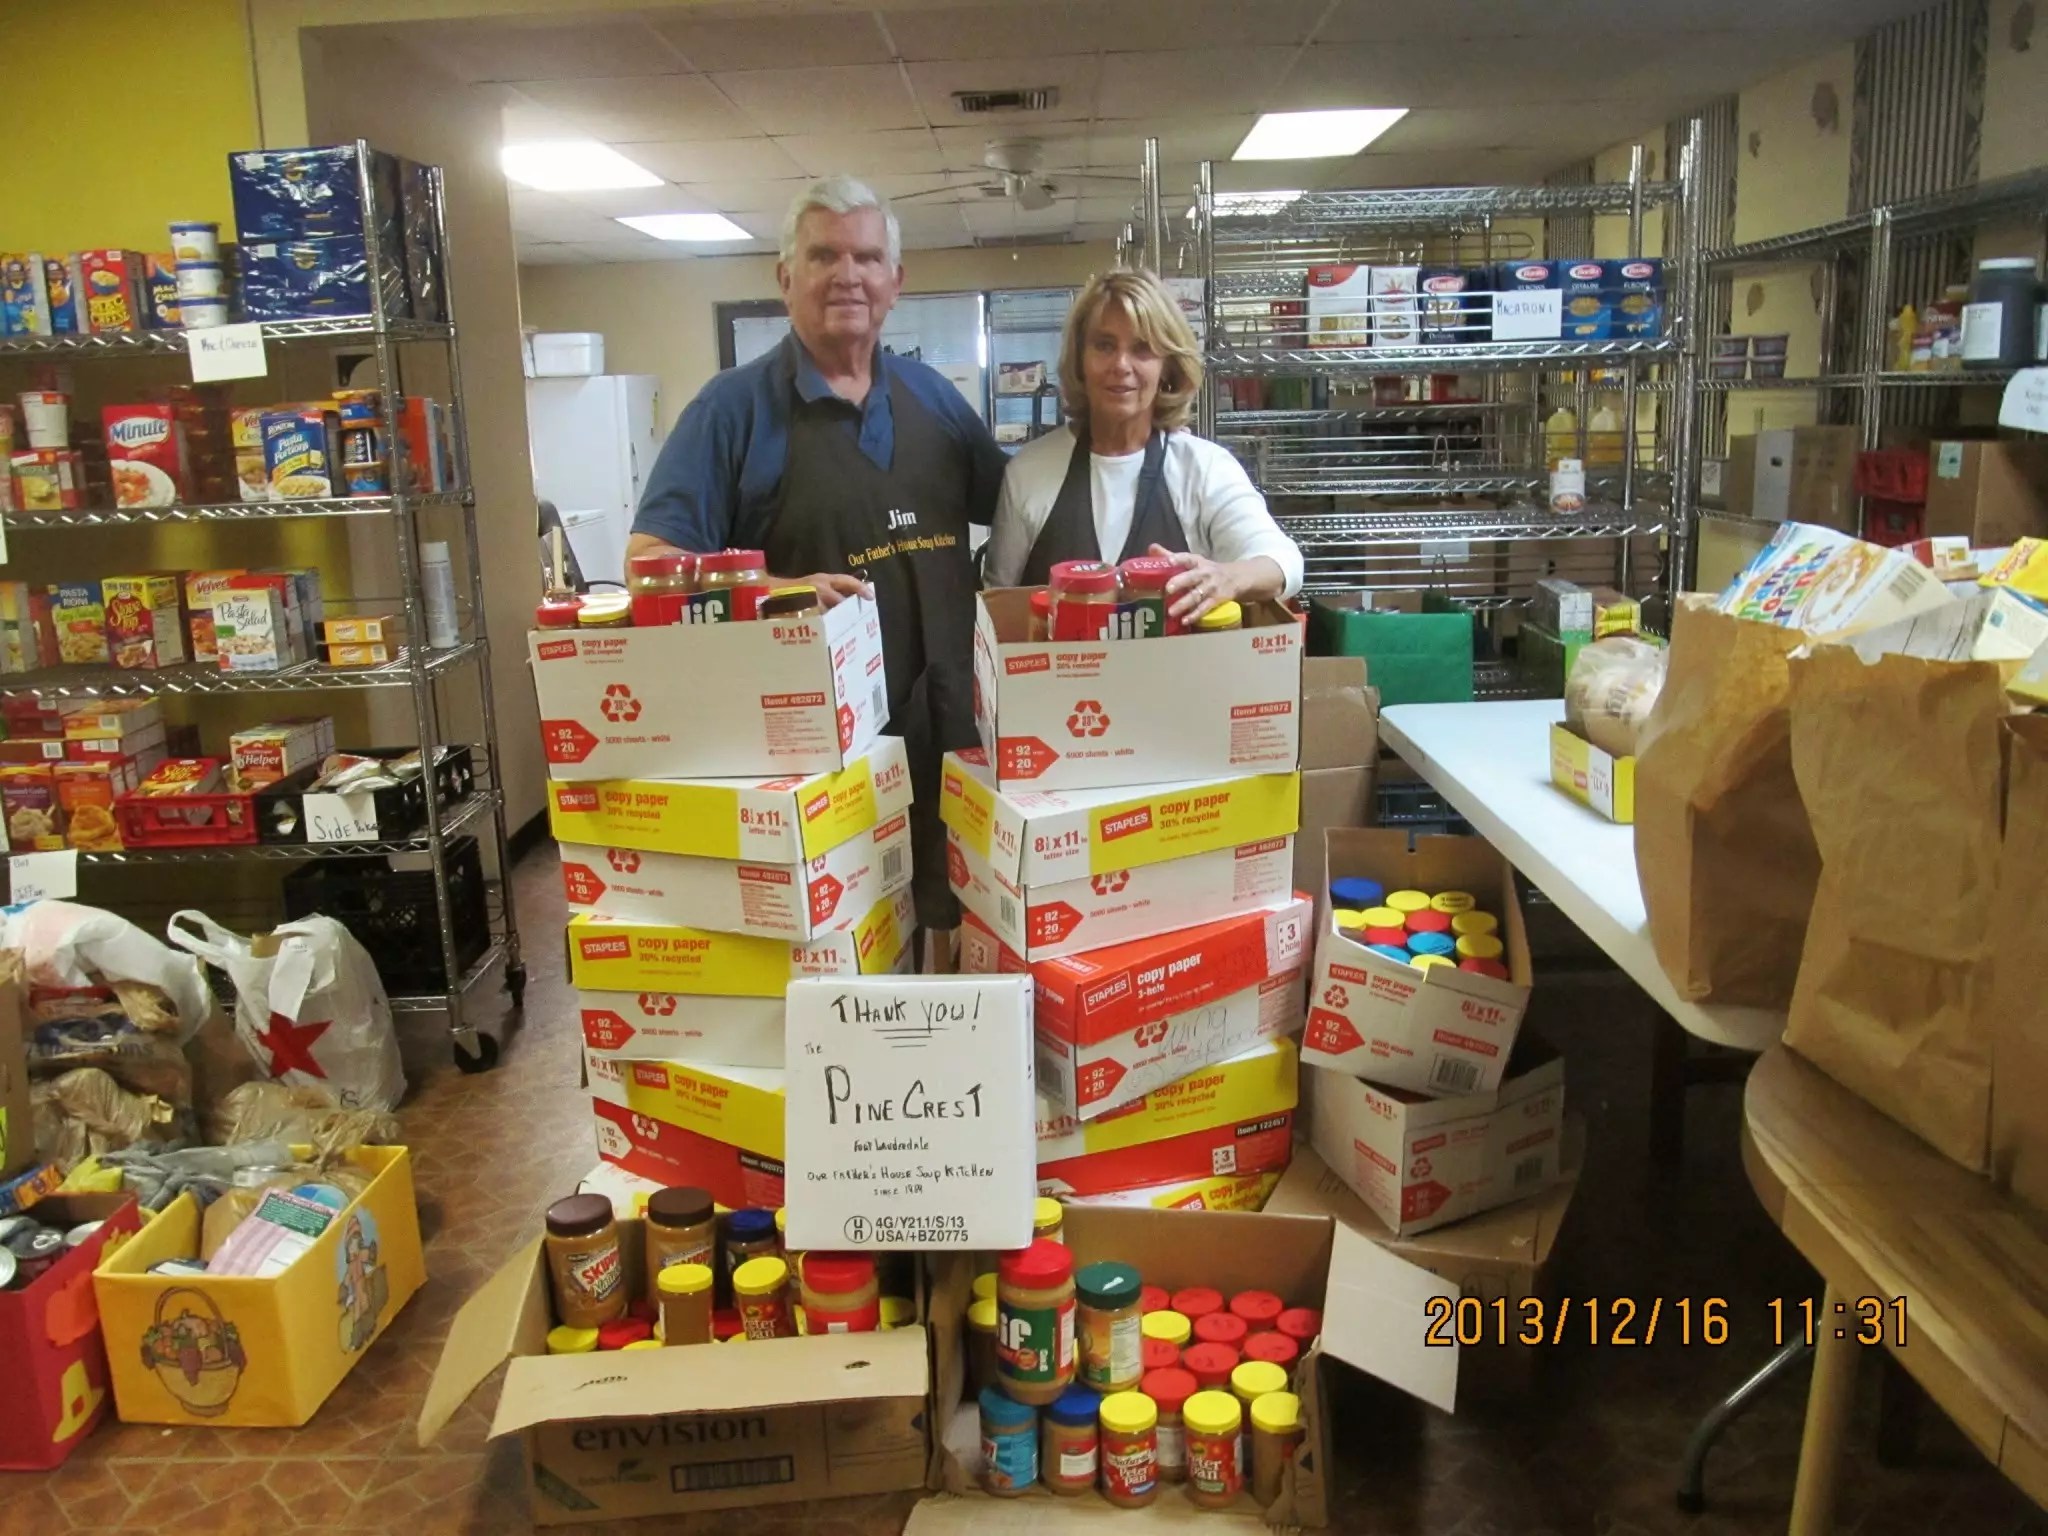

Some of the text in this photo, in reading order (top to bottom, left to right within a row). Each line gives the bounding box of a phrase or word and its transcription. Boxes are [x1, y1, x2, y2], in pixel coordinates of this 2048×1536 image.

[111, 419, 168, 444] Minute
[888, 509, 917, 530] Jim
[848, 553, 865, 566] Our
[865, 542, 896, 560] Father's
[896, 538, 918, 552] House
[917, 536, 933, 551] Soup
[1099, 607, 1156, 640] Jif
[540, 645, 573, 655] STAPLES
[604, 639, 628, 647] paper
[1056, 652, 1107, 661] copy paper
[1008, 658, 1047, 670] STAPLES
[558, 729, 572, 739] 92
[561, 743, 575, 752] 20
[1016, 745, 1031, 755] 92
[244, 755, 280, 765] Helper
[1017, 759, 1031, 768] 20
[605, 790, 669, 806] copy paper
[1160, 792, 1231, 816] copy paper
[1105, 812, 1148, 834] STAPLES
[1160, 810, 1220, 830] 30% recycled
[314, 816, 351, 840] Side
[1045, 924, 1058, 934] 20
[1287, 923, 1296, 940] 3
[583, 941, 626, 954] STAPLES
[638, 937, 711, 951] copy paper
[662, 954, 701, 964] recycled
[1137, 952, 1202, 985] copy paper
[1088, 980, 1127, 1006] STAPLES
[1137, 983, 1165, 998] 3-hole
[830, 994, 907, 1024] THANK
[597, 1018, 611, 1028] 92
[1326, 1020, 1340, 1031] 92
[599, 1030, 613, 1040] 20
[1322, 1034, 1337, 1044] 20
[636, 1069, 666, 1084] STAPLES
[1092, 1067, 1104, 1078] 92
[674, 1074, 730, 1098] copy paper
[1093, 1082, 1105, 1092] 20
[1154, 1073, 1225, 1101] copy paper
[1177, 1090, 1216, 1108] recycled
[1222, 1150, 1230, 1162] 3
[876, 1230, 969, 1242] USA/+BZ0775
[1000, 1312, 1032, 1350] if
[572, 1414, 767, 1451] envision
